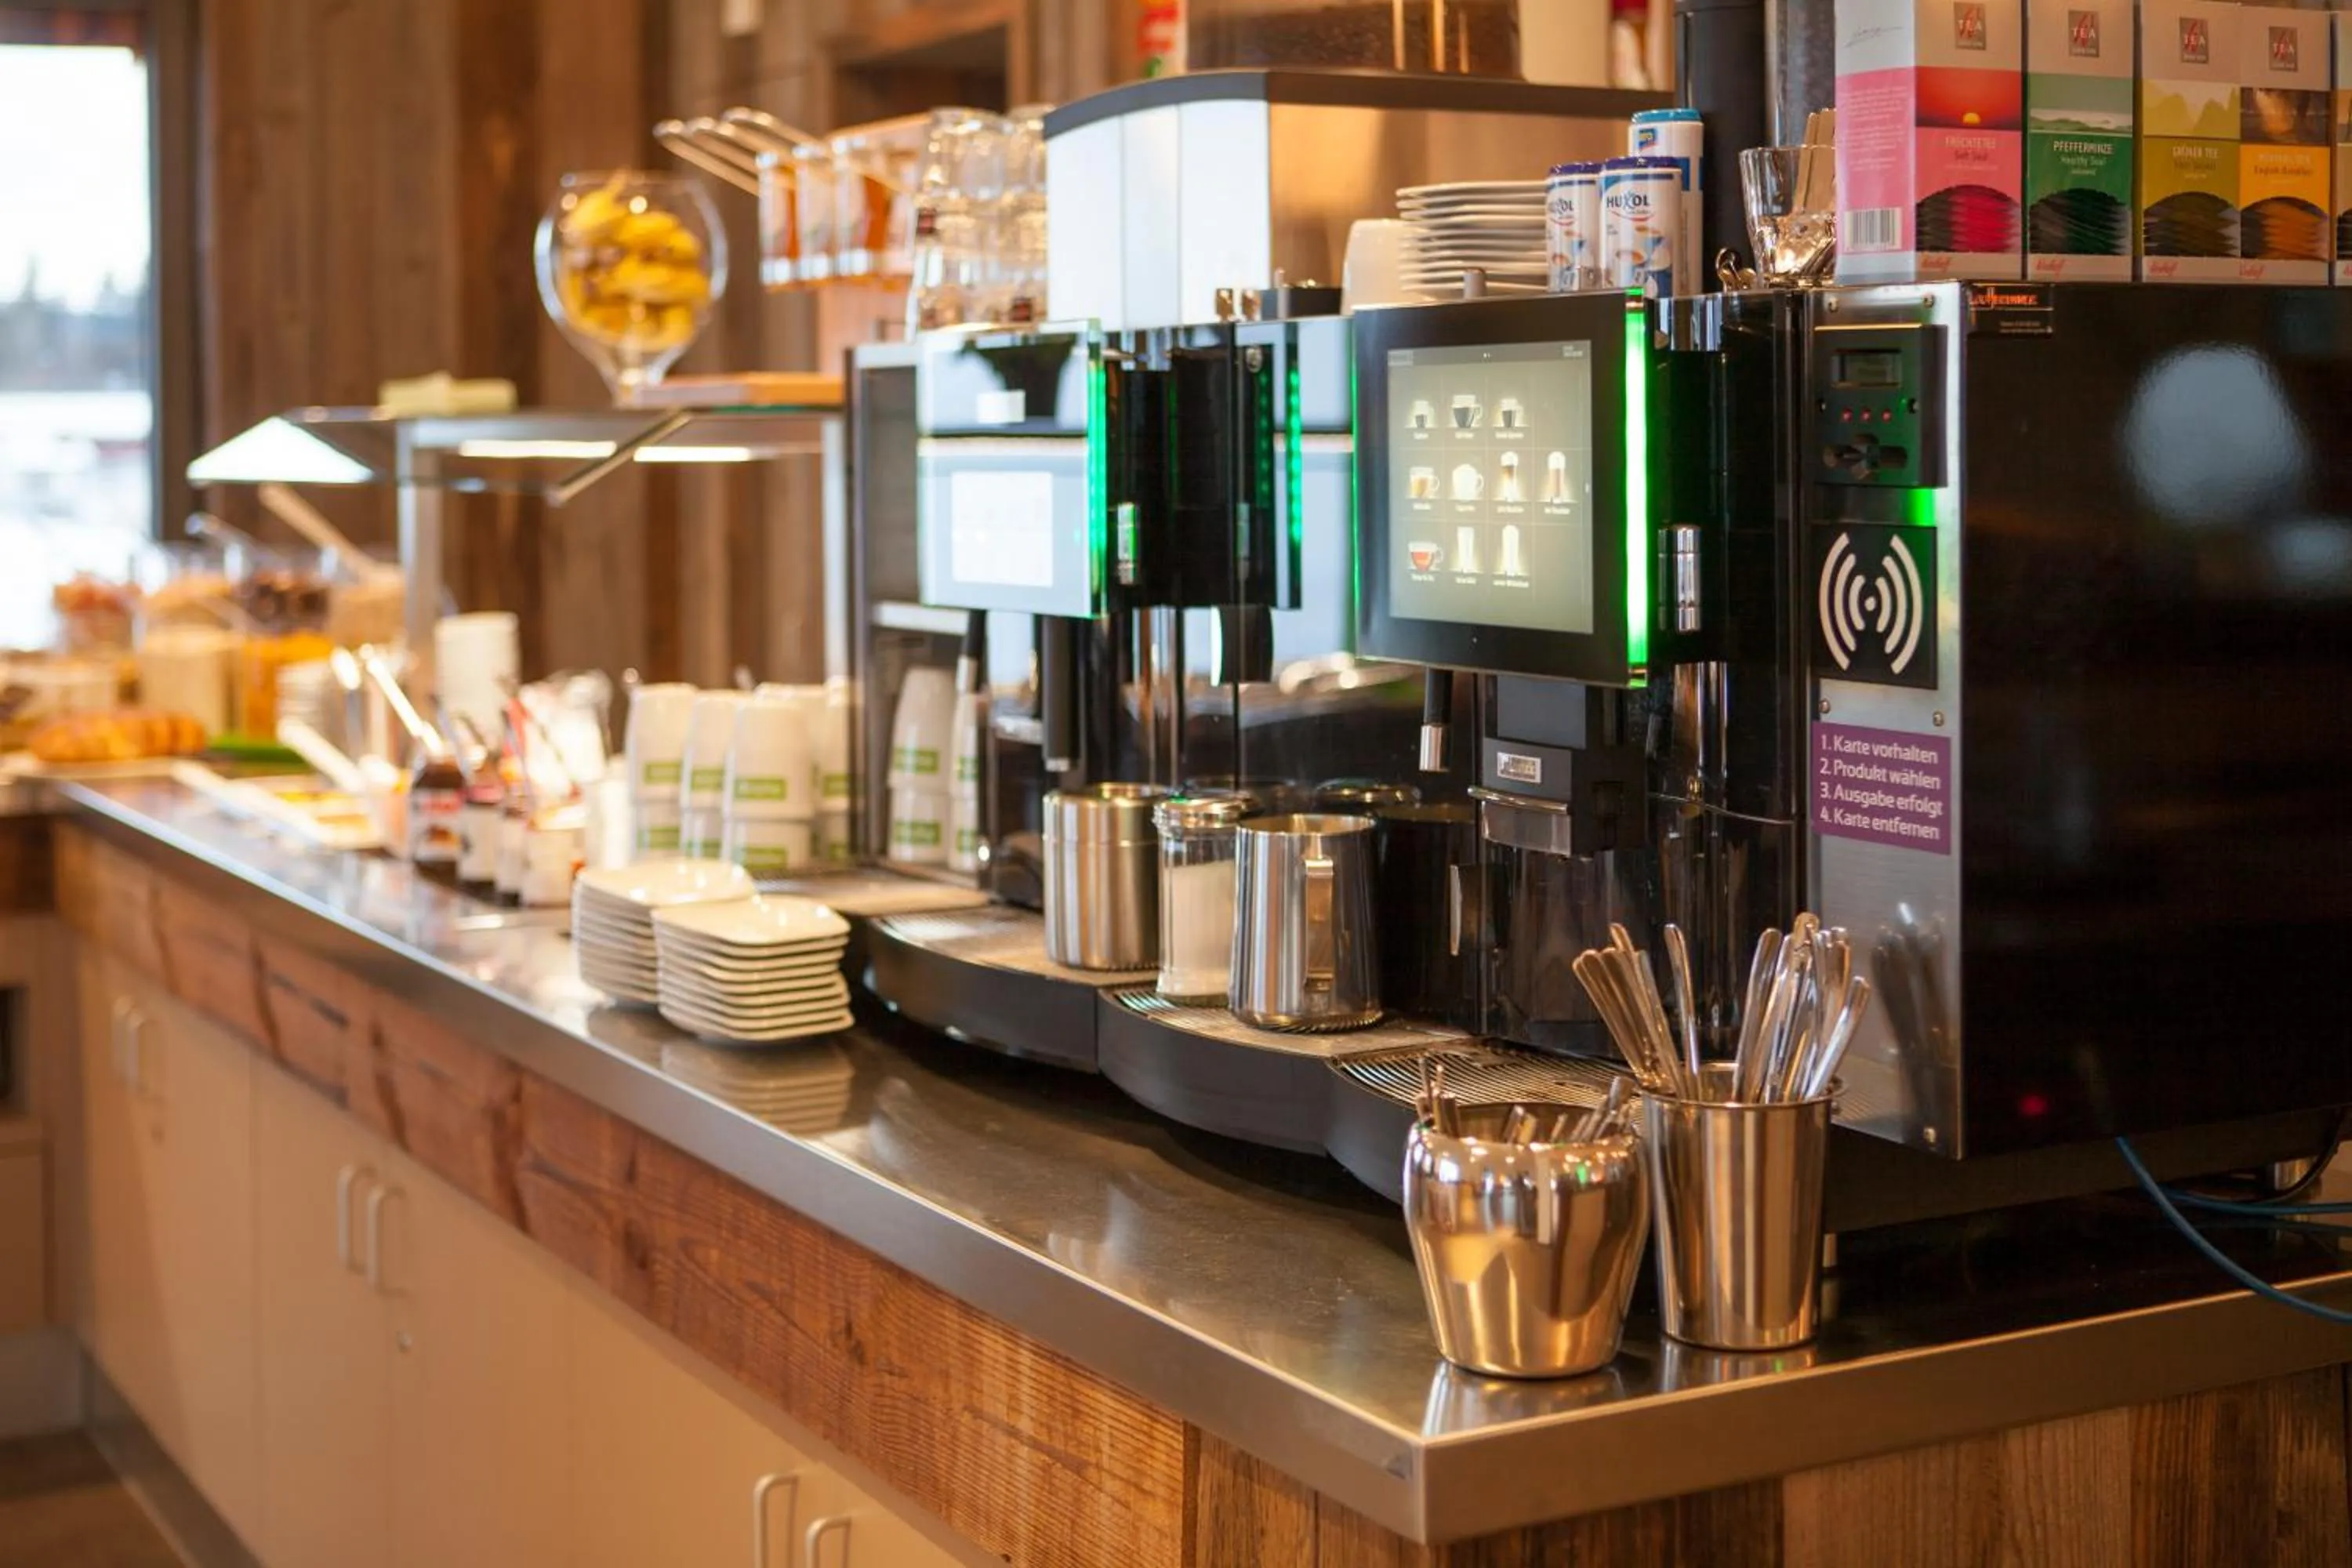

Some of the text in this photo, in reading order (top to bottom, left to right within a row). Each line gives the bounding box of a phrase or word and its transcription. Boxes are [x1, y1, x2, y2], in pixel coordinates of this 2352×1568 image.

[1958, 19, 1983, 32] TEA
[2072, 27, 2096, 39] TEA
[2184, 34, 2206, 45] TEA
[2273, 42, 2295, 55] TEA
[2053, 140, 2114, 155] PFEFFERMINZE
[2205, 147, 2219, 158] TEE
[1607, 191, 1650, 209] HUXOL
[1820, 735, 1939, 764] 1. Karte vorhalten
[1820, 758, 1941, 789] 2. Produkt wählen
[1820, 782, 1944, 818] 3. Ausgabe erfolgt
[1820, 806, 1940, 840] 4. Karte entfernen
